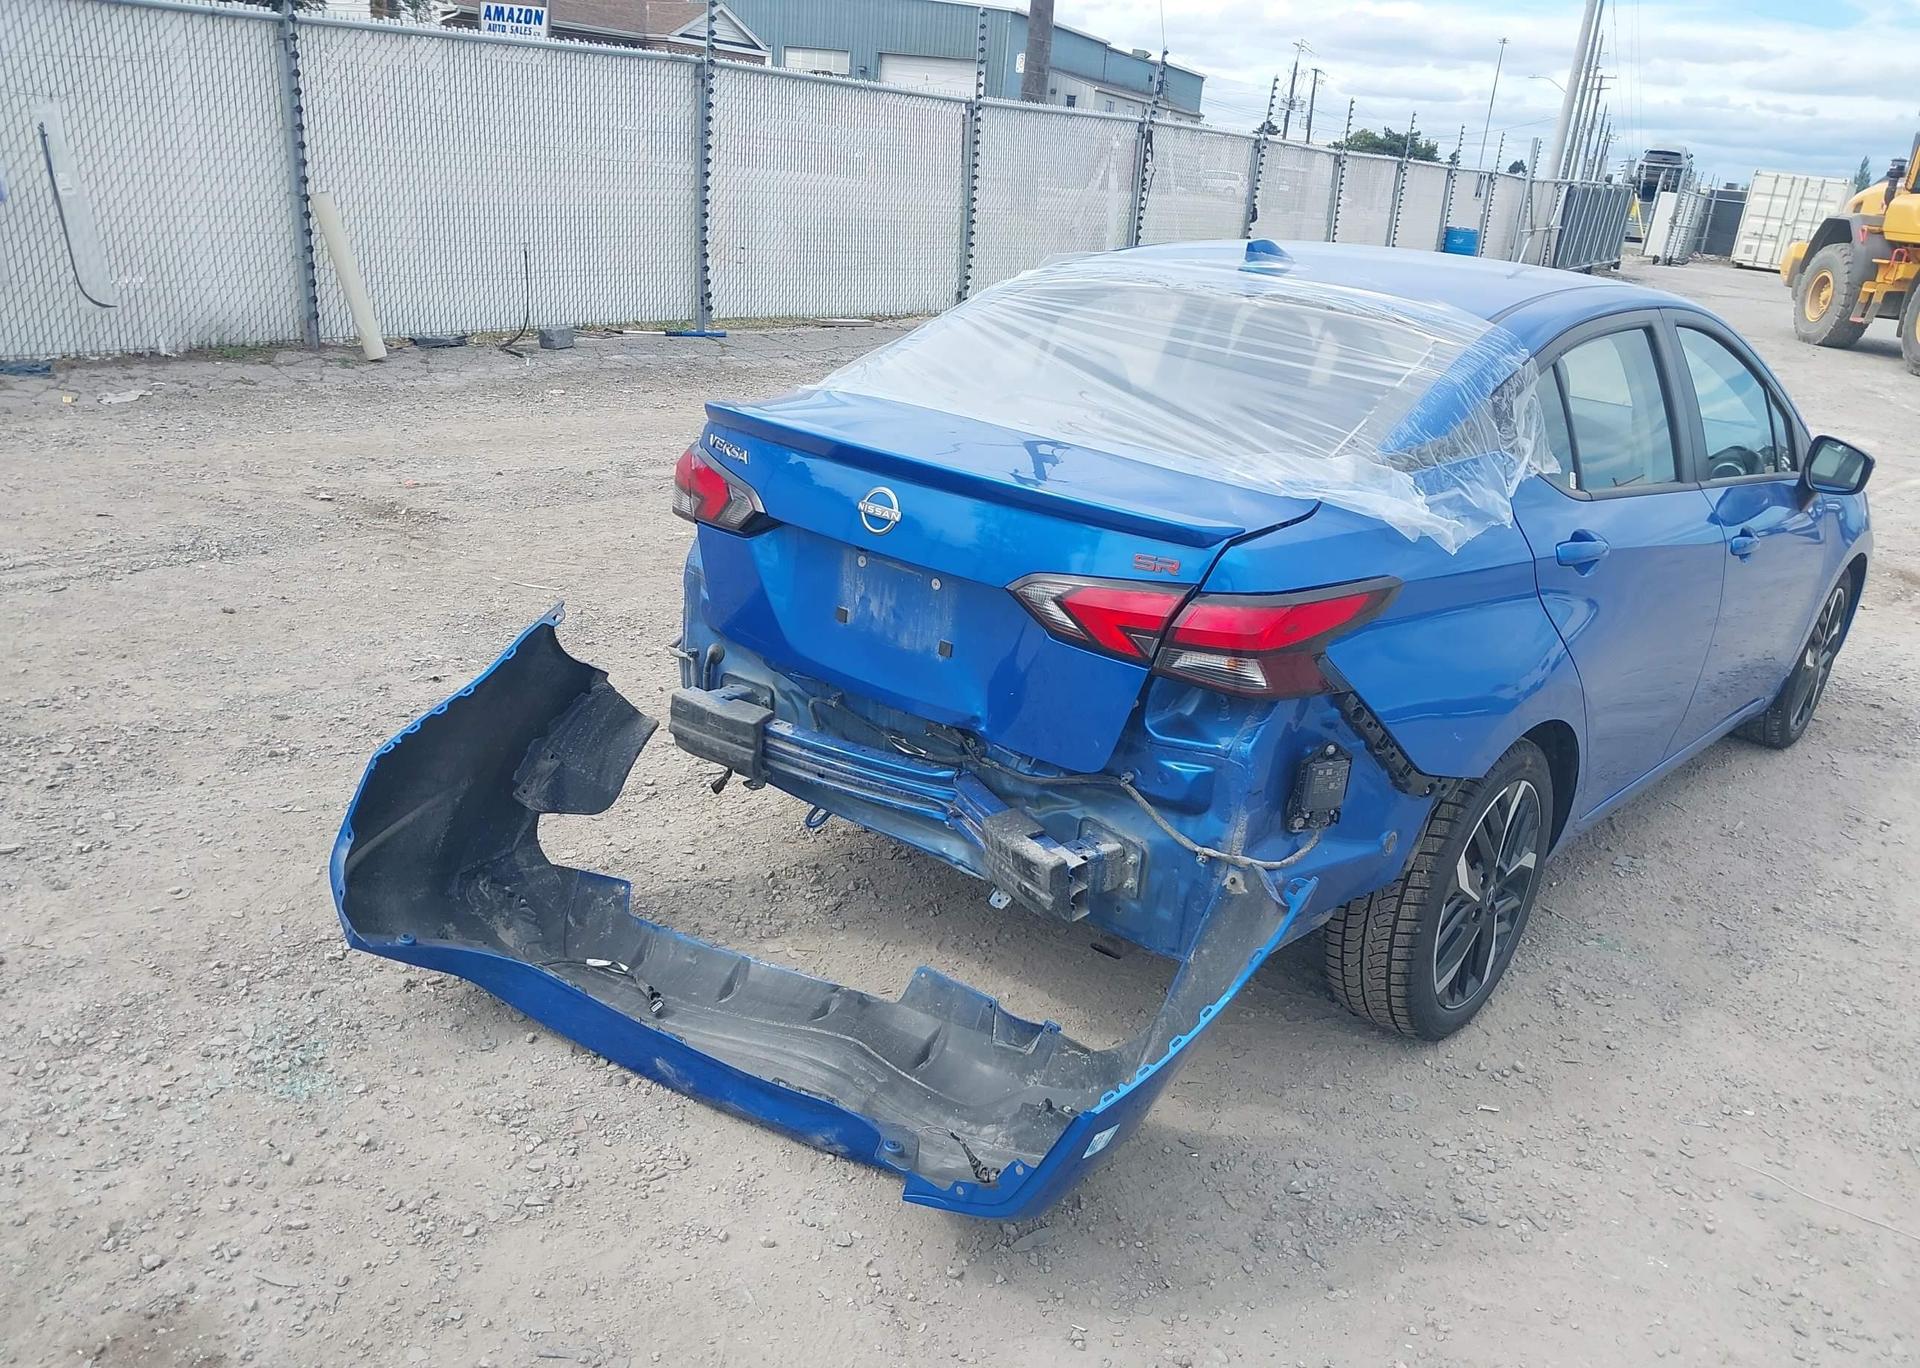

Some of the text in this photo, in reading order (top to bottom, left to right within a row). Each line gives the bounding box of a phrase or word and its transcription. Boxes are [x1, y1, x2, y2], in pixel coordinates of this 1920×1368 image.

[483, 5, 544, 26] AMAZON
[487, 23, 506, 33] AUTO
[510, 25, 532, 36] SALES
[709, 433, 749, 465] VERSA
[858, 501, 901, 522] NISSAN
[1133, 553, 1181, 576] SR
